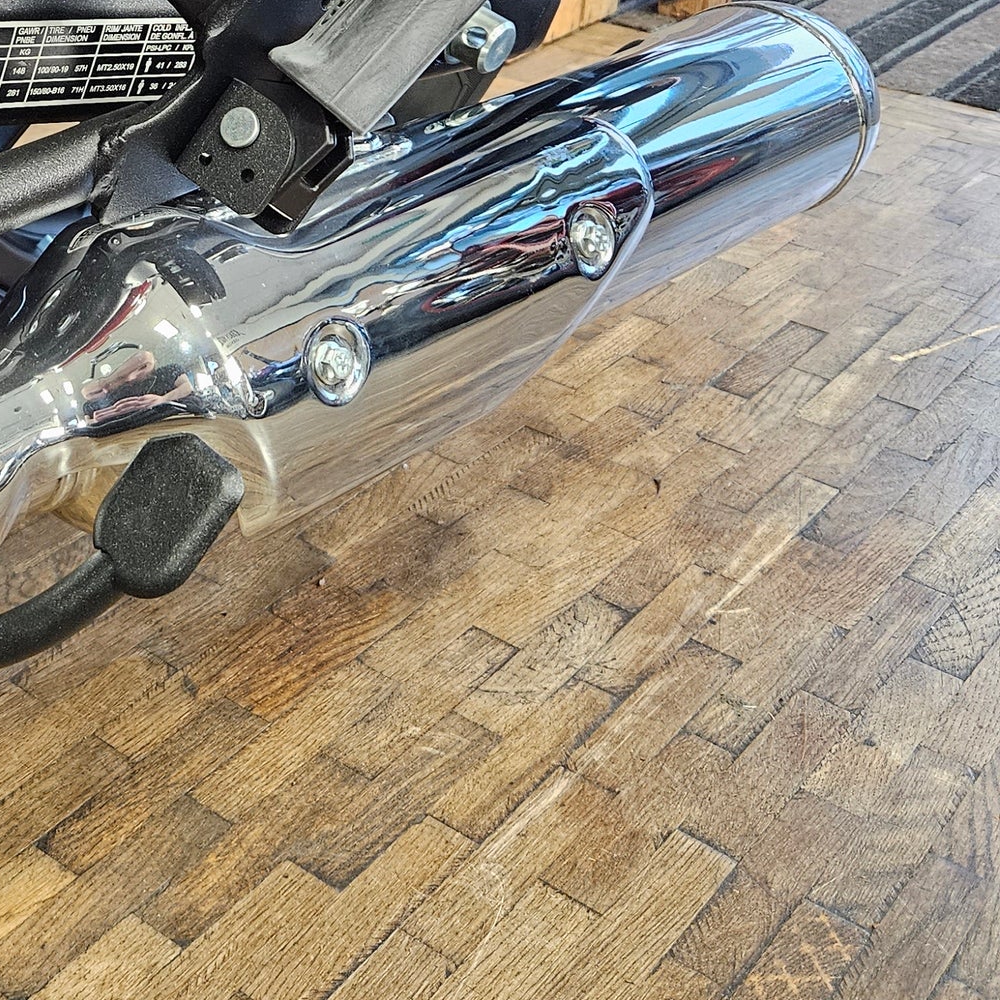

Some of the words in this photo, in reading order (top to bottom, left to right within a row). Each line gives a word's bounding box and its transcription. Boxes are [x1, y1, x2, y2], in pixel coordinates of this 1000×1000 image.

[49, 27, 65, 35] TIRE
[76, 25, 96, 34] PNEU
[121, 25, 143, 33] JANTE
[152, 24, 172, 32] COLD
[15, 36, 37, 44] PNBE
[46, 34, 88, 43] DIMENSION
[103, 33, 141, 41] DIMENSION
[150, 32, 162, 40] DE
[155, 61, 165, 69] 41
[12, 66, 26, 75] 148
